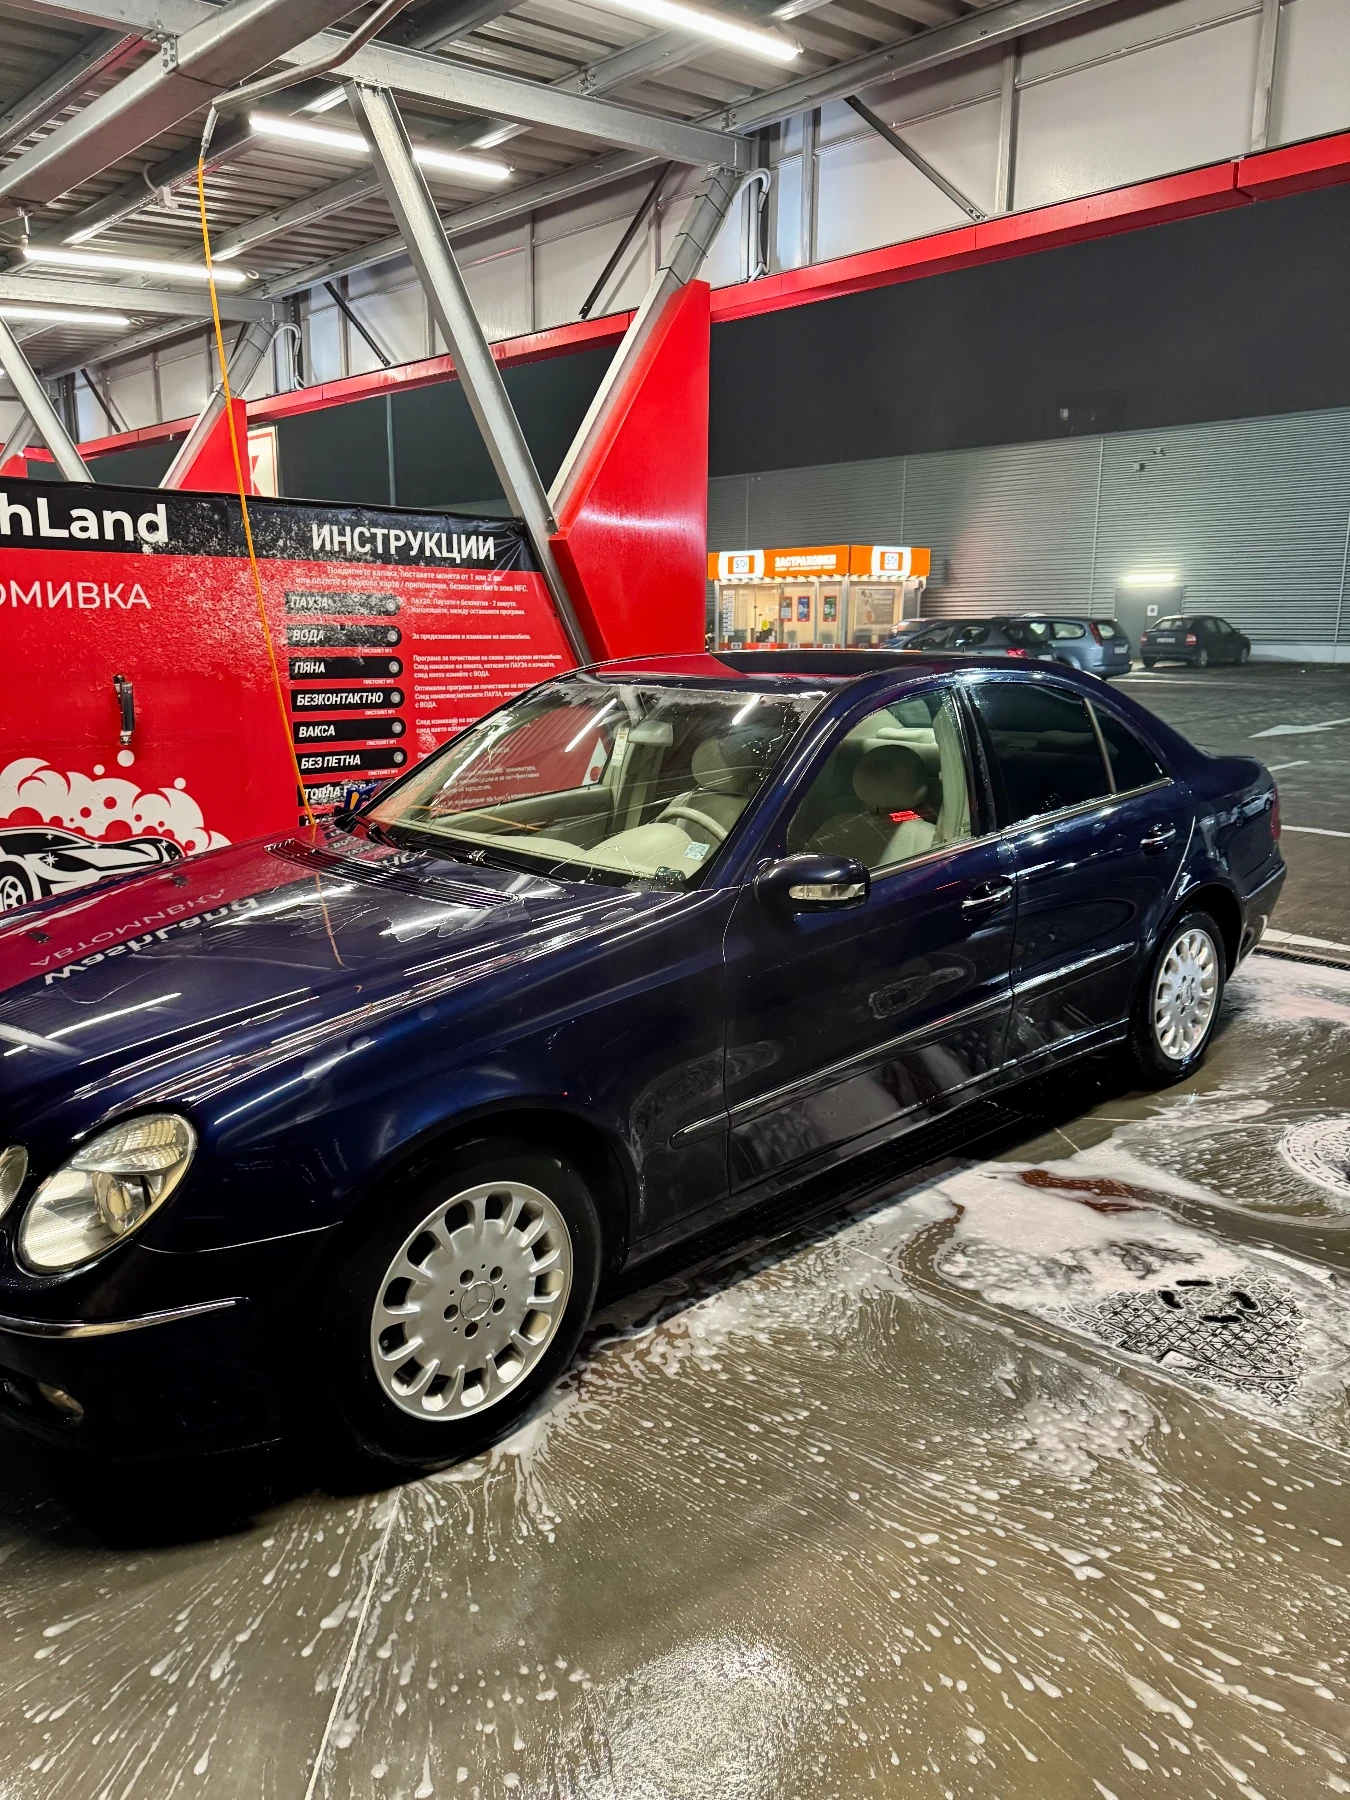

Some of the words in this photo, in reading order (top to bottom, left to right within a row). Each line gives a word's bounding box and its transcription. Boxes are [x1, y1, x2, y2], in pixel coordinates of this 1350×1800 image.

[0, 492, 169, 542] hLand
[311, 523, 495, 564] ИНСТРУКЦИИ
[327, 566, 371, 576] Повдигнете
[372, 569, 399, 579] капака,
[400, 570, 435, 579] поставете
[436, 572, 460, 580] монета
[487, 574, 492, 582] 2
[405, 581, 448, 591] приложение,
[449, 582, 494, 592] безконтактно
[514, 584, 528, 593] NFC.
[0, 580, 151, 609] МИВКА
[290, 596, 328, 608] ПАУЗА
[450, 608, 469, 616] между
[292, 629, 324, 643] ВОДА
[412, 632, 419, 640] За
[413, 654, 441, 663] Програма
[294, 662, 326, 674] ПЯНА
[413, 663, 429, 671] След
[510, 661, 527, 669] ПАУЗА
[414, 684, 446, 692] Оптимална
[447, 684, 472, 692] програма
[296, 692, 384, 706] БЕЗКОНТАКТНО
[414, 693, 430, 701] След
[484, 690, 503, 698] ПАУЗА,
[416, 718, 431, 726] След
[298, 724, 336, 738] ВАКСА
[300, 756, 323, 769] БЕЗ
[323, 754, 361, 767] ПЕТНА
[304, 786, 341, 800] ТОПЛА
